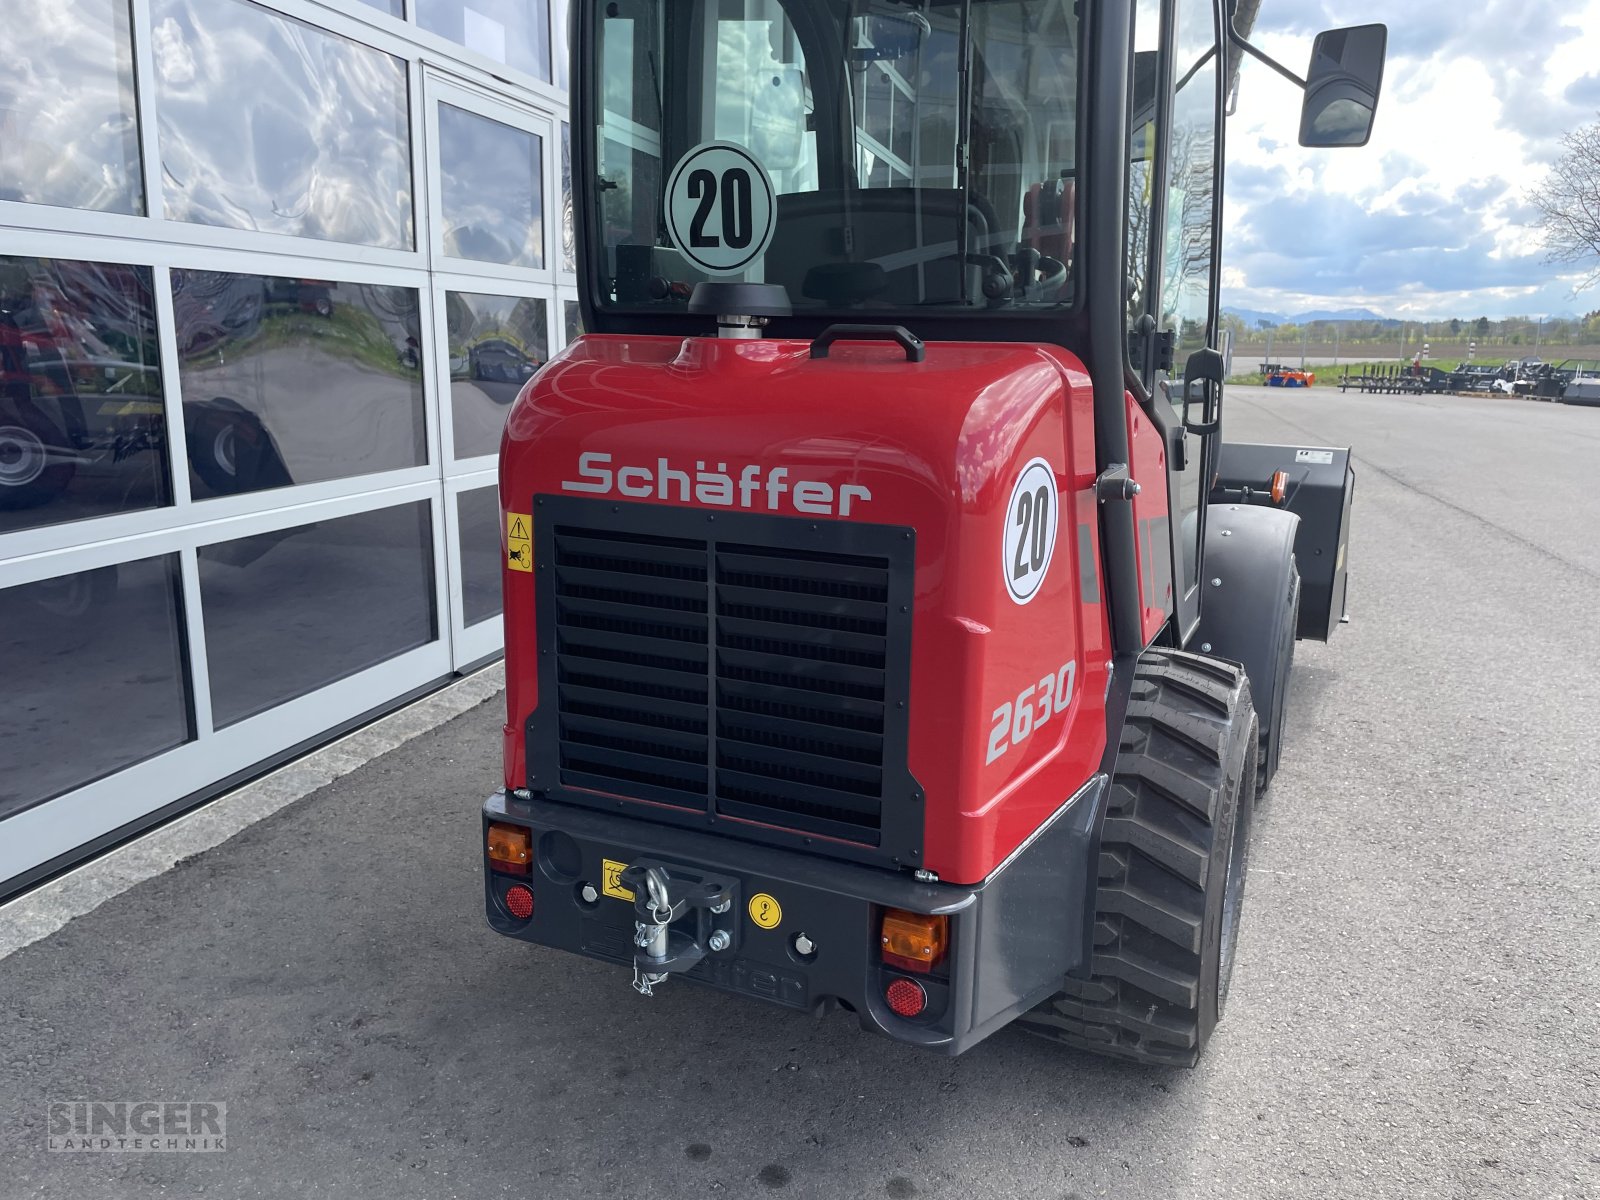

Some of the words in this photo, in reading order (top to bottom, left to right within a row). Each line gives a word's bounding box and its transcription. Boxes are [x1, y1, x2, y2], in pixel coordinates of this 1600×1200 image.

[687, 167, 753, 250] 20
[561, 451, 872, 517] Schäffer
[1013, 485, 1049, 581] 20
[985, 659, 1076, 766] 2630
